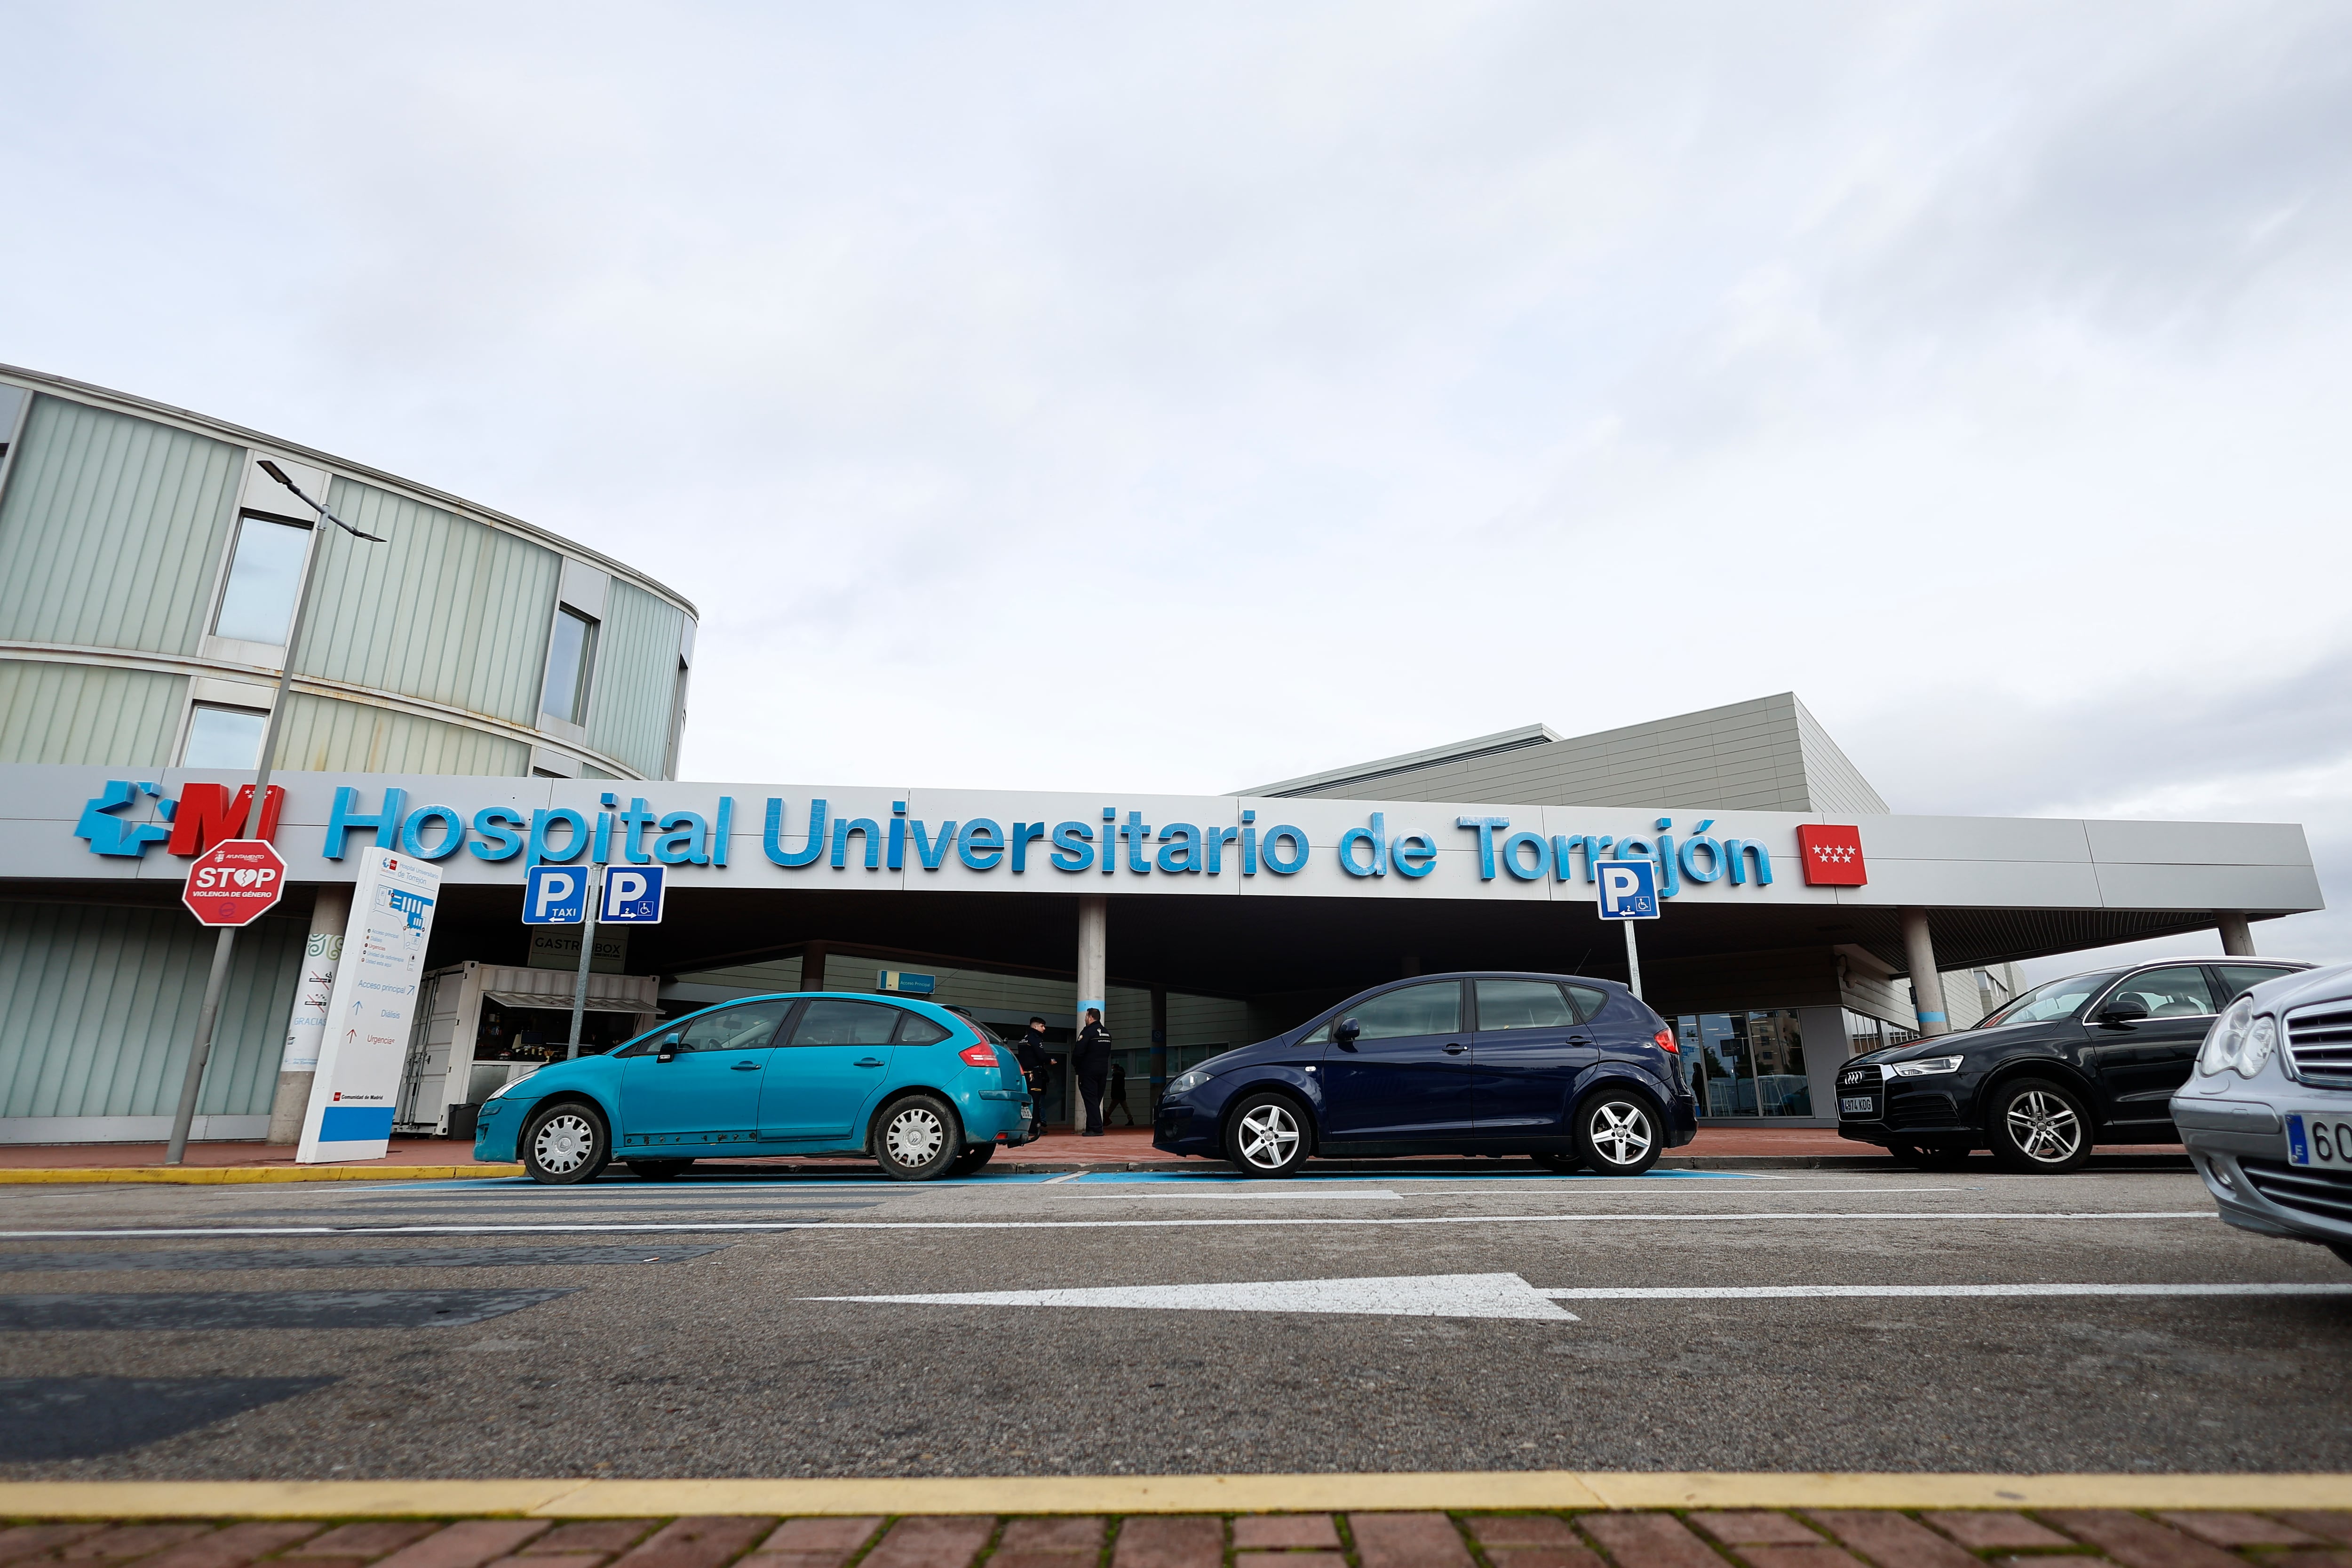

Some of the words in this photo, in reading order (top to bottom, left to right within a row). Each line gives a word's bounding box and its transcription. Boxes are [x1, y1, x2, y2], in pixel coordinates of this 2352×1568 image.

[322, 785, 734, 879] Hospital
[763, 797, 1311, 875] Universitario
[1339, 812, 1438, 878] de
[196, 867, 276, 888] STOP
[399, 862, 414, 871] Hospital
[415, 868, 438, 879] Universitario
[406, 872, 427, 884] Torrejón
[535, 873, 574, 917] P
[607, 872, 647, 916] P
[1603, 868, 1639, 912] P
[552, 908, 576, 916] TAXI
[535, 937, 621, 954] GASTRBOX
[358, 979, 381, 990] Acceso
[381, 984, 406, 995] principal
[294, 1017, 327, 1027] GRACIAS
[381, 1009, 400, 1019] Diálisis
[367, 1035, 395, 1045] Urgencias
[1845, 1100, 1858, 1111] 4974
[1859, 1099, 1871, 1110] KDG
[2295, 1144, 2304, 1155] E
[2312, 1121, 2352, 1163] 60
